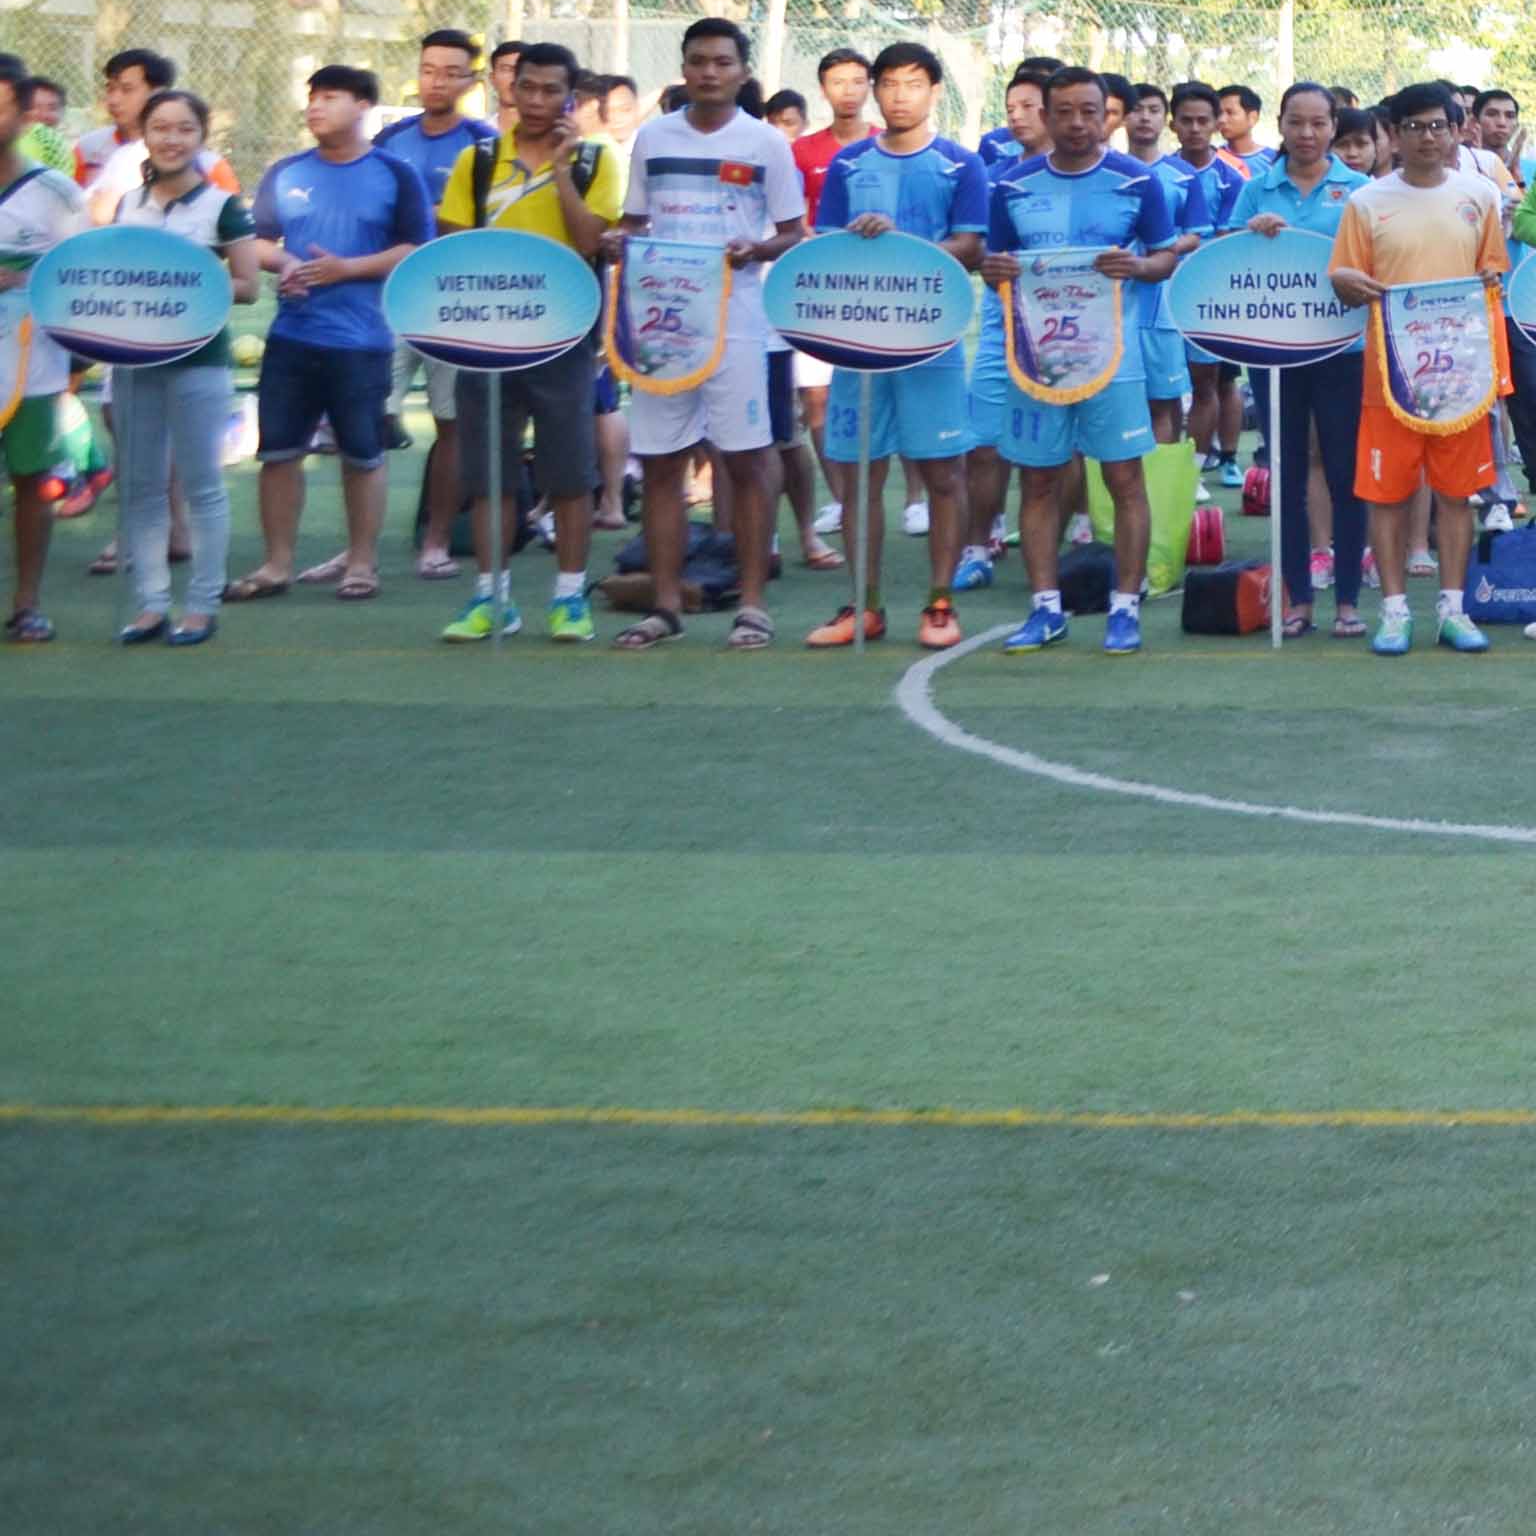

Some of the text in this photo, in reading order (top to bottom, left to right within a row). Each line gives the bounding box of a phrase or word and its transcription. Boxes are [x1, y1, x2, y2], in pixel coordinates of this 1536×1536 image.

[57, 268, 203, 287] VIETCOMBANK
[436, 273, 546, 292] VIETINBANK
[795, 272, 820, 289] AN
[825, 273, 869, 291] NINH
[873, 275, 917, 293] KINH
[1230, 268, 1317, 291] HẢI QUAN
[640, 306, 684, 334] 25
[1197, 297, 1240, 320] TỈNH
[1039, 315, 1080, 346] 25
[1414, 348, 1454, 378] 25
